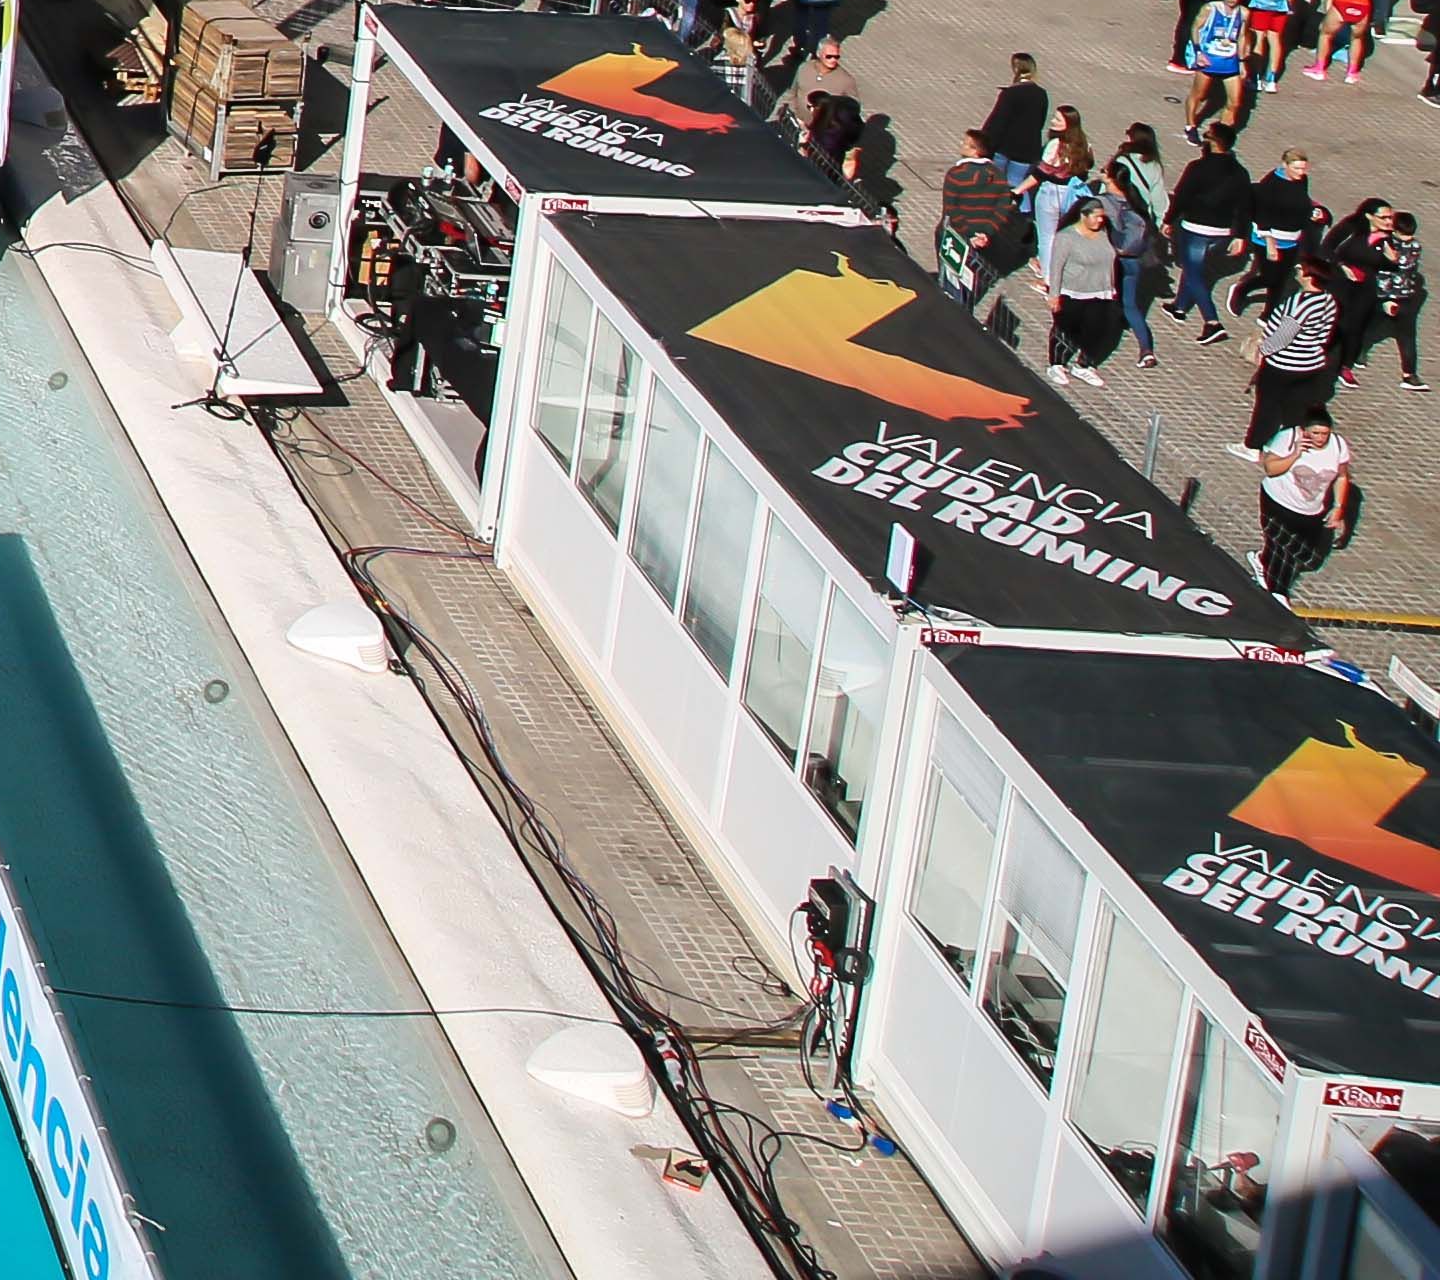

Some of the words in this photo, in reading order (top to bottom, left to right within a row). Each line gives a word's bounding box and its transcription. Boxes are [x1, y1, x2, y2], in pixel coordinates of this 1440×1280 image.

[479, 107, 539, 134] DEL
[498, 102, 627, 147] CIUDAD
[518, 93, 665, 148] VALENCIA
[812, 455, 926, 512] DEL
[842, 442, 1085, 536] CIUDAD
[876, 421, 1156, 540] VALENCIA
[1162, 867, 1267, 926] DEL
[1186, 852, 1409, 952] CIUDAD
